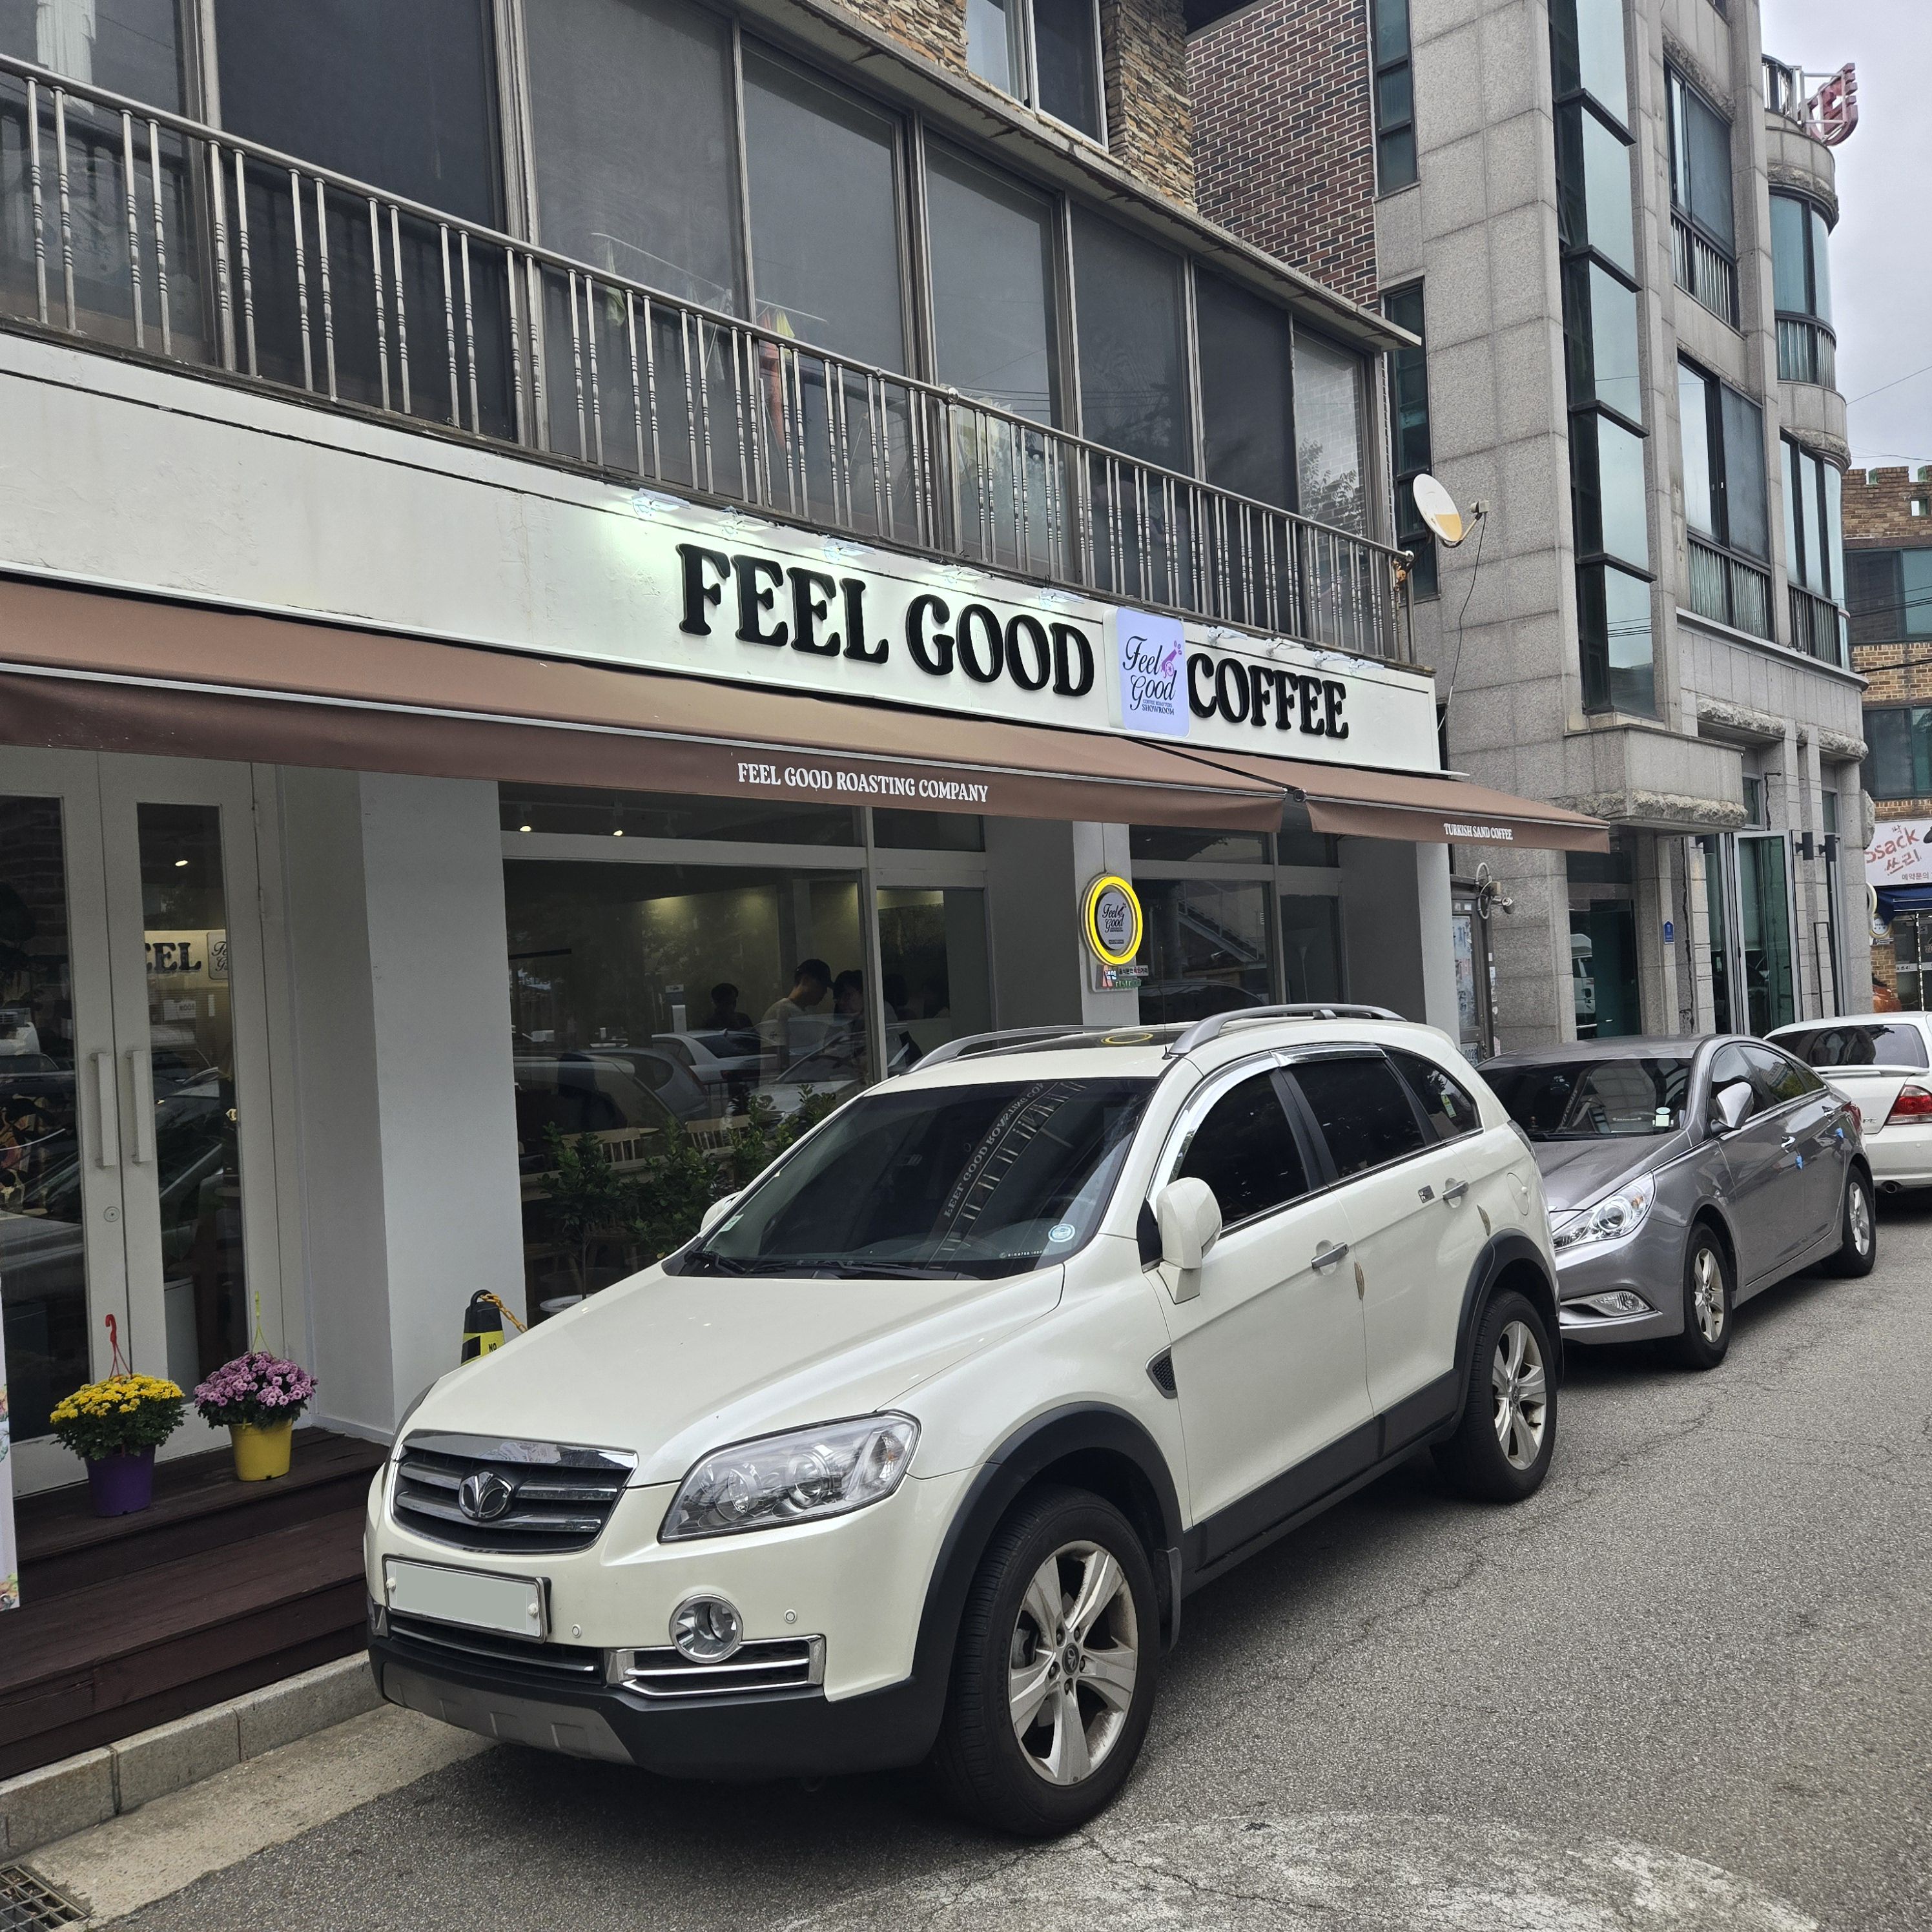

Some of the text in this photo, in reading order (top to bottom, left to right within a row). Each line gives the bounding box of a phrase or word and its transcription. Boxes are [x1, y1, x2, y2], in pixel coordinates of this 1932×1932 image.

[676, 543, 1094, 697] FEEL GOOD
[1122, 635, 1163, 675] Feel
[1130, 670, 1178, 711] Good
[1187, 652, 1349, 739] COFFEE
[1142, 704, 1175, 715] SHOWROOM
[738, 763, 988, 803] FEEL GOOD ROASTING COMPANY
[1443, 823, 1513, 840] TURKISH SAND COFFEE
[1902, 872, 1929, 881] 예약문의
[1102, 903, 1119, 918] Feel
[1105, 914, 1124, 933] Good
[488, 1342, 497, 1353] NO
